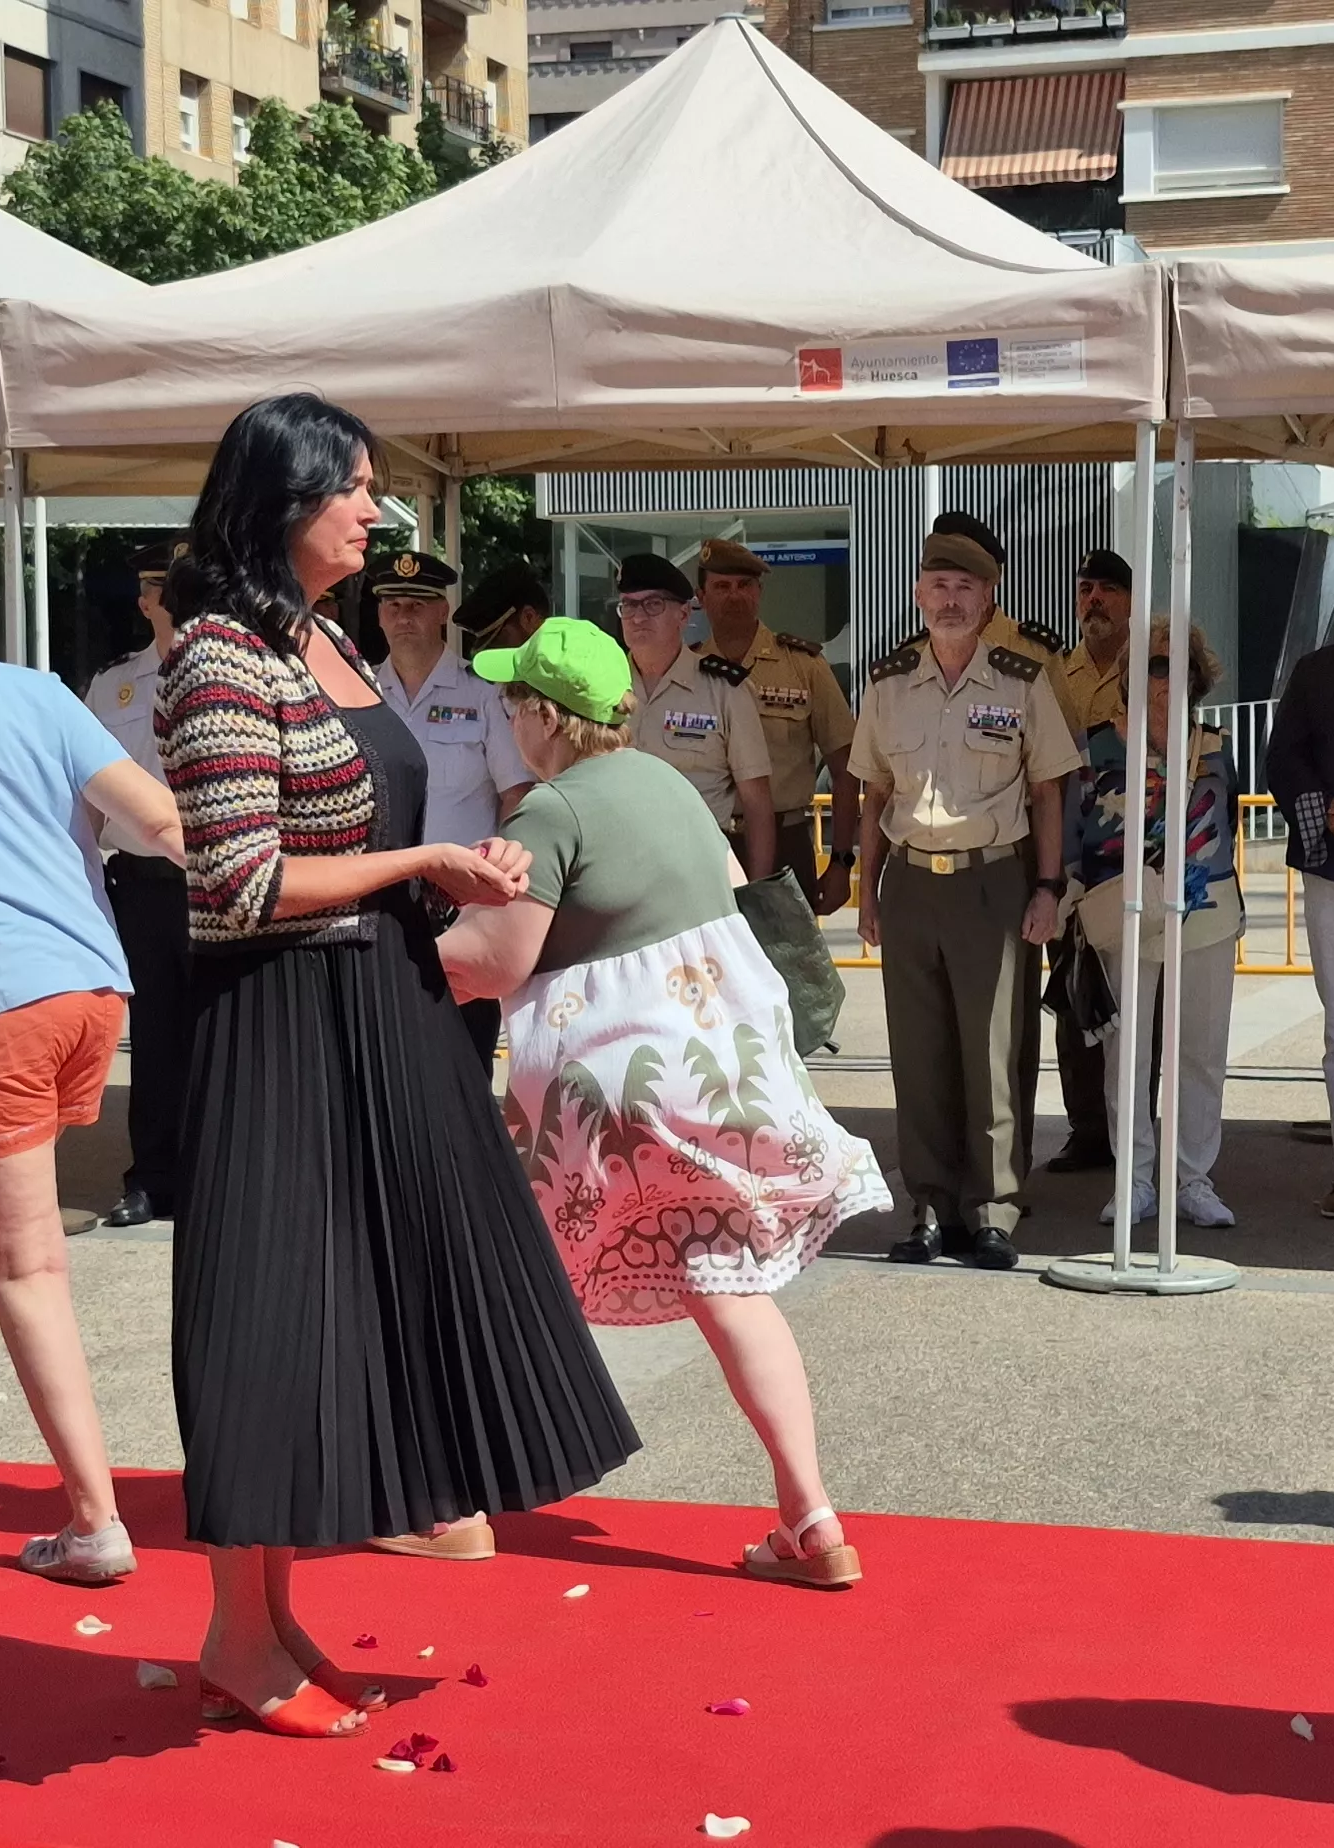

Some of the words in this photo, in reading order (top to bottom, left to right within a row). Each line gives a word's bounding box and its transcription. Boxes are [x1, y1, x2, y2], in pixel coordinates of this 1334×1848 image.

[850, 355, 939, 371] Ayuntamiento
[851, 372, 867, 383] de
[870, 371, 919, 382] Huesca
